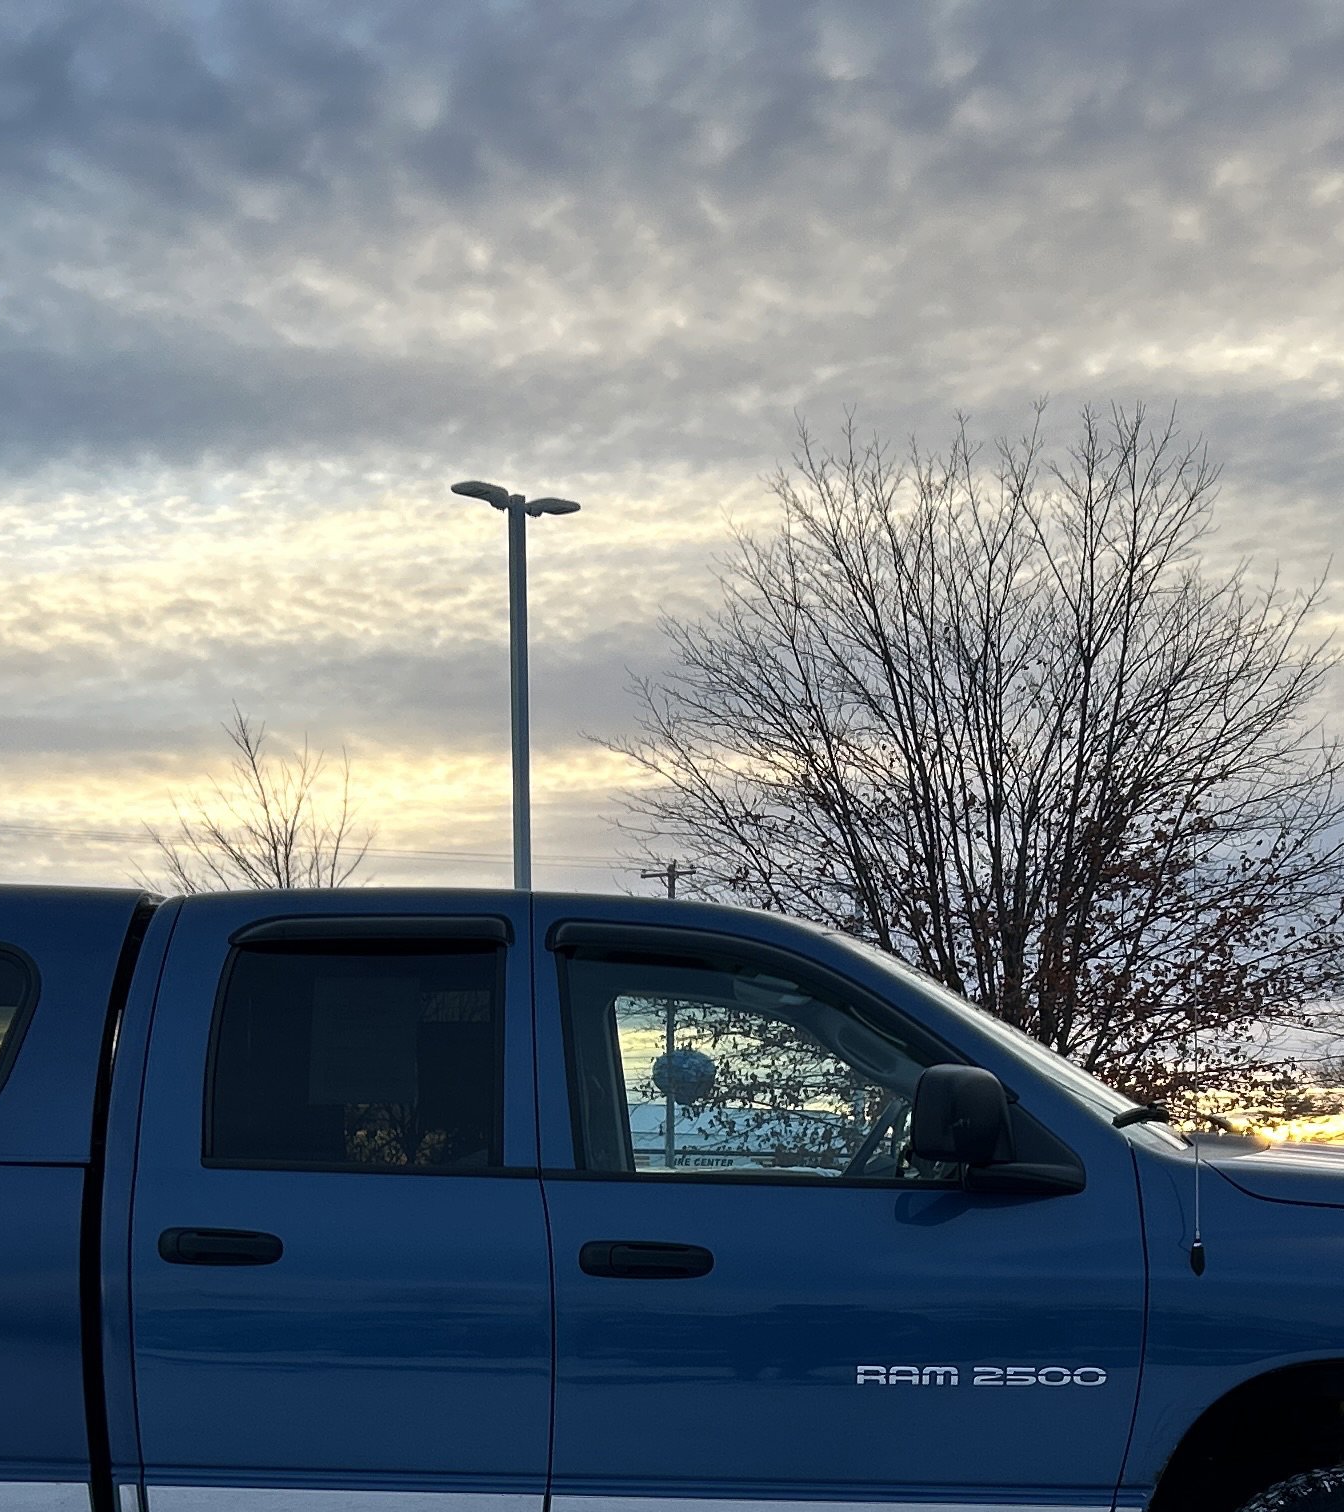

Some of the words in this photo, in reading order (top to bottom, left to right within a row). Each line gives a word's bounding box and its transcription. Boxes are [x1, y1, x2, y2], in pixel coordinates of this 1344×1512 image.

[672, 1157, 691, 1166] IRE
[694, 1157, 734, 1167] CENTER
[856, 1365, 959, 1386] RAM
[973, 1366, 1107, 1387] 2500
